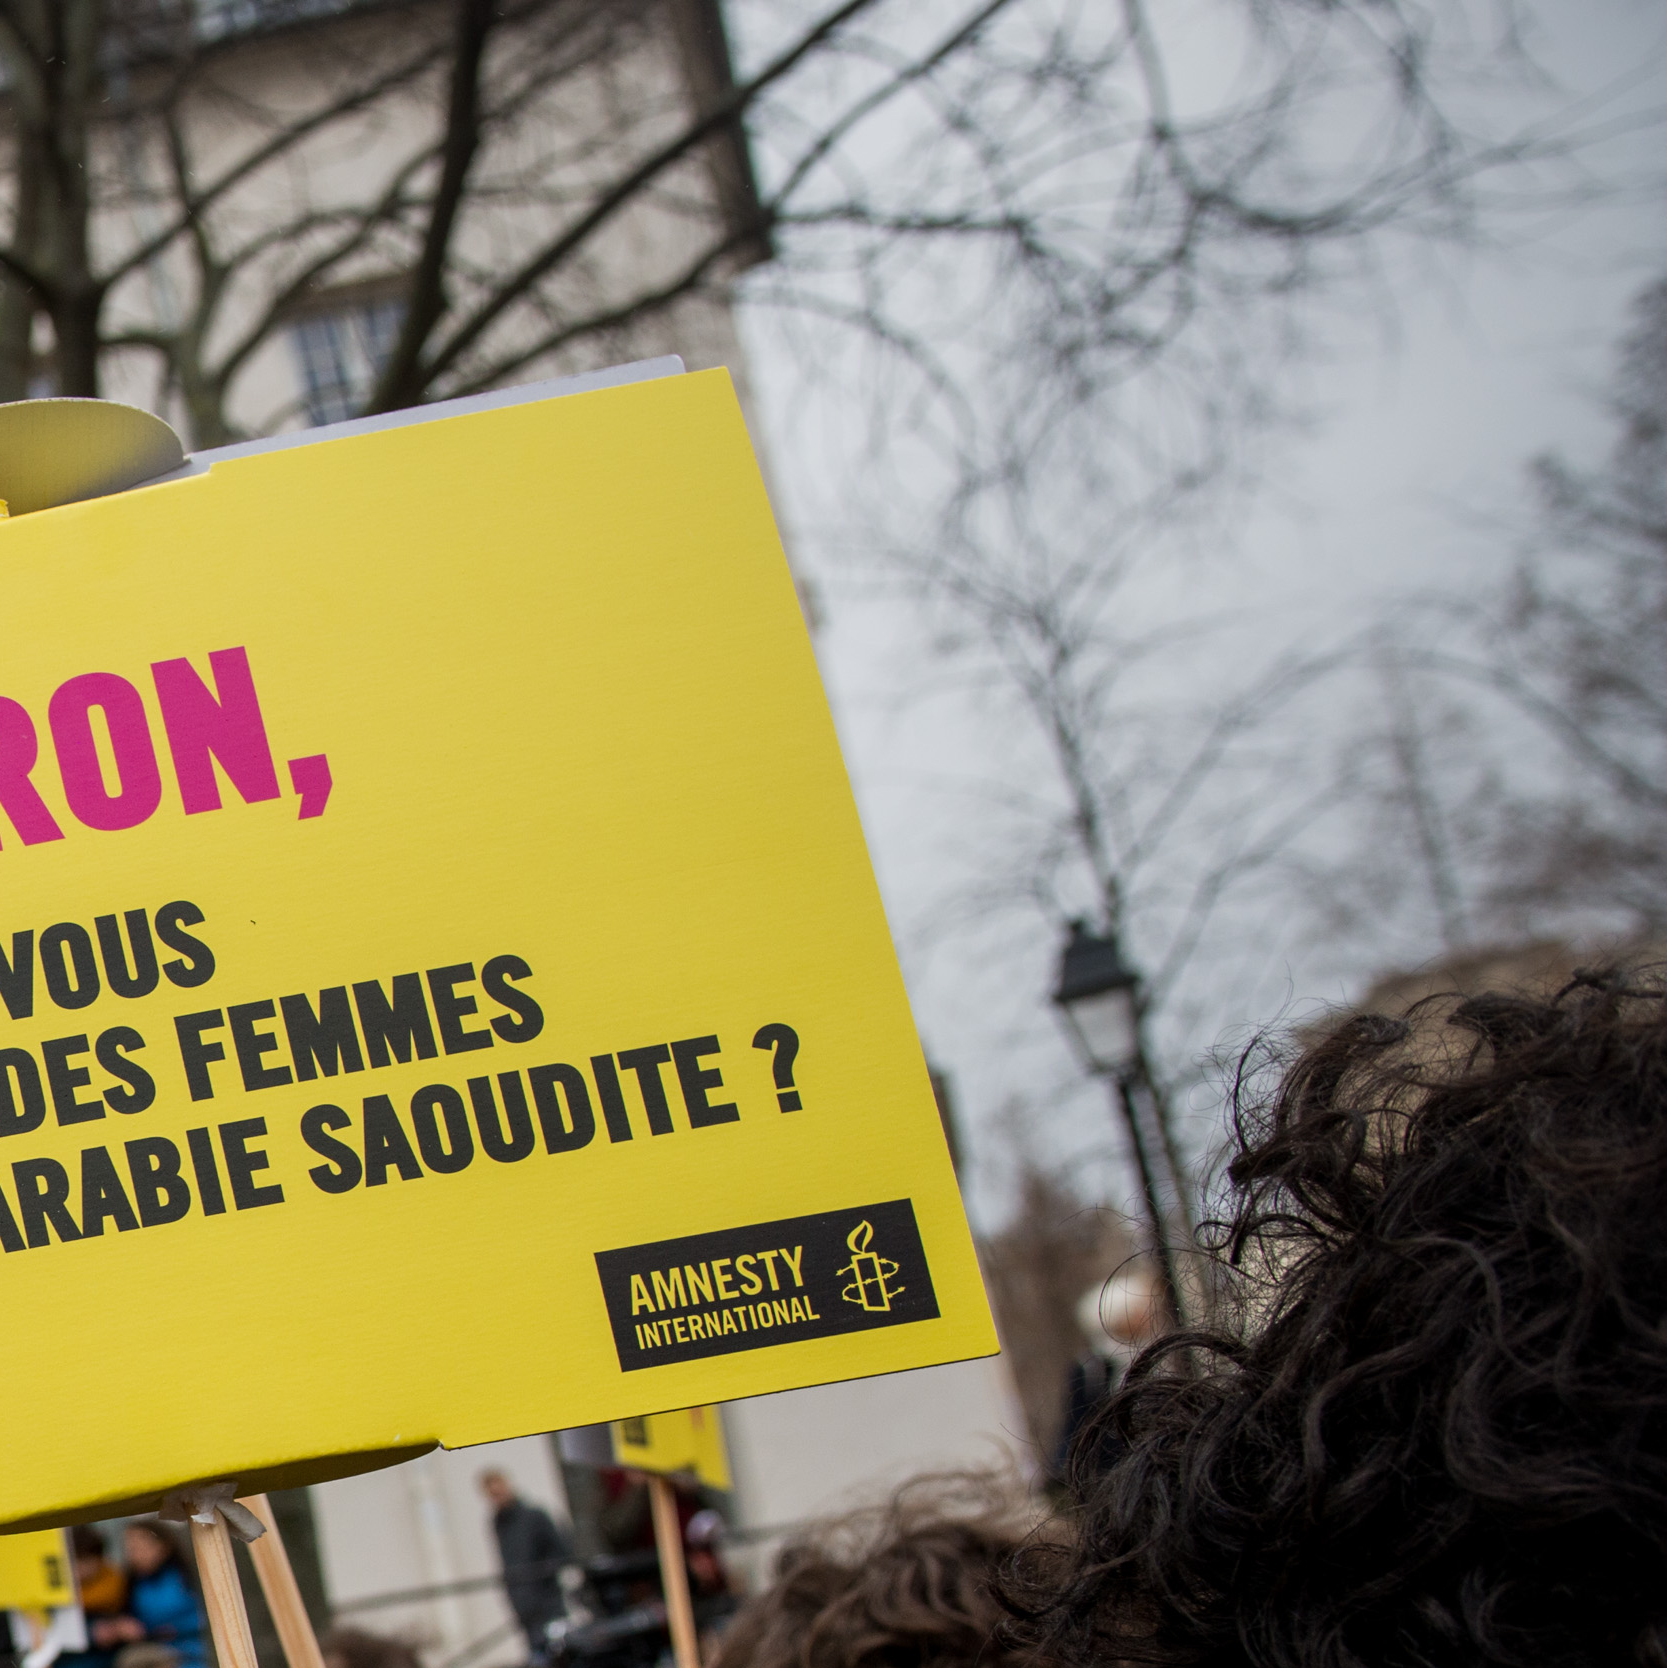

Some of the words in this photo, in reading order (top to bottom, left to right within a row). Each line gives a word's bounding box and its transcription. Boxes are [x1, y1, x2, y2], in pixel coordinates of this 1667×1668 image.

[173, 954, 545, 1102] FEMMES
[299, 1034, 741, 1194] SAOUDITE
[751, 1022, 804, 1114] ?
[630, 1245, 804, 1317] AMNESTY
[634, 1295, 820, 1350] INTERNATIONAL
